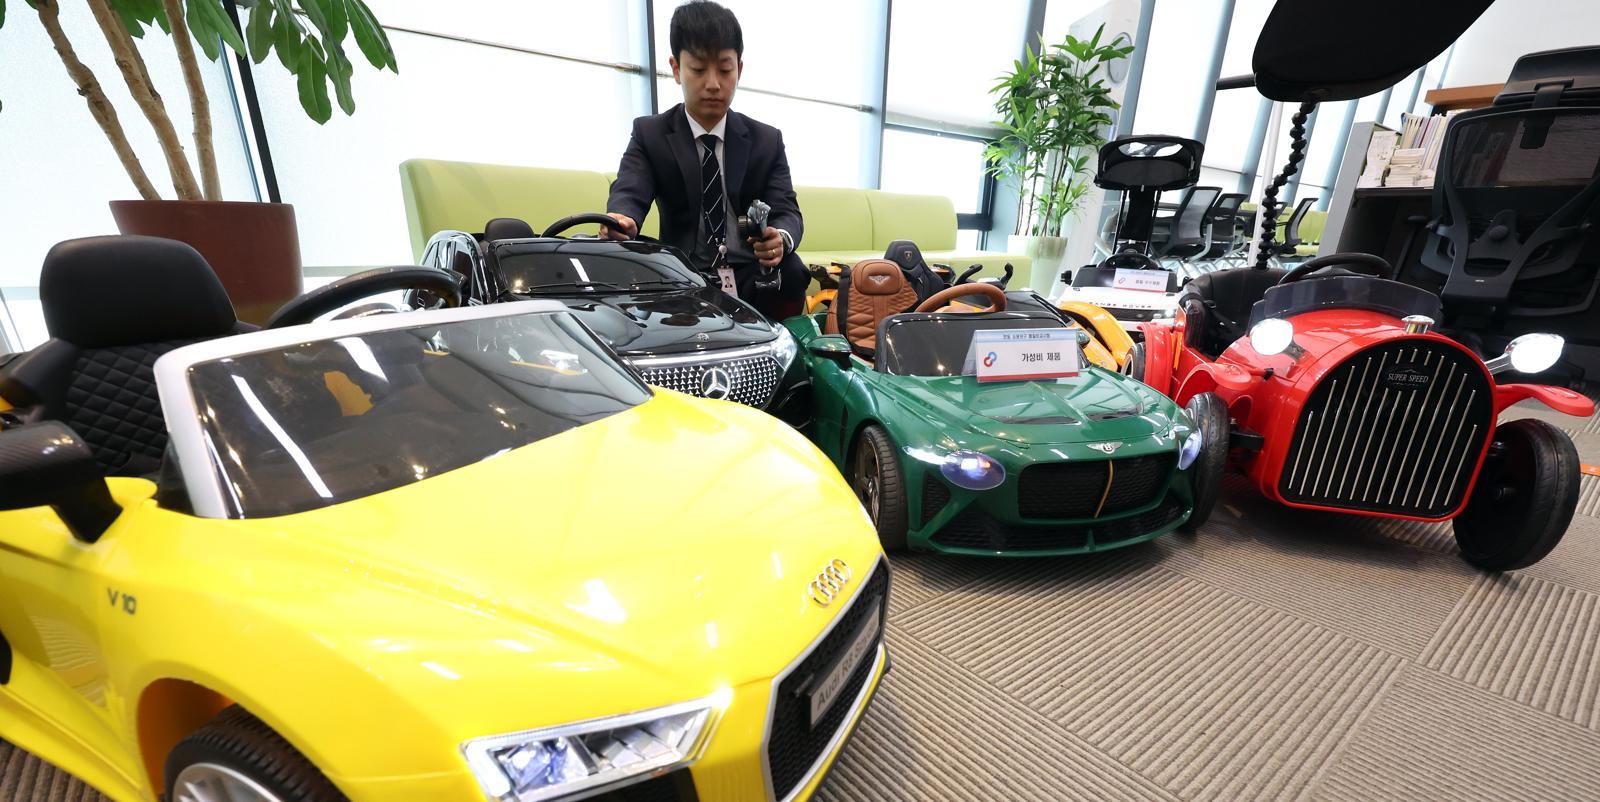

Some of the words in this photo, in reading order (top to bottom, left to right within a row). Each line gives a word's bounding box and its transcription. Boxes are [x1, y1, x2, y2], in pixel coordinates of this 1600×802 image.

[1021, 353, 1044, 362] 가성비
[1046, 352, 1061, 361] 제품
[1387, 373, 1408, 381] SUPER
[1408, 374, 1429, 383] SPEED
[817, 671, 840, 710] Audi
